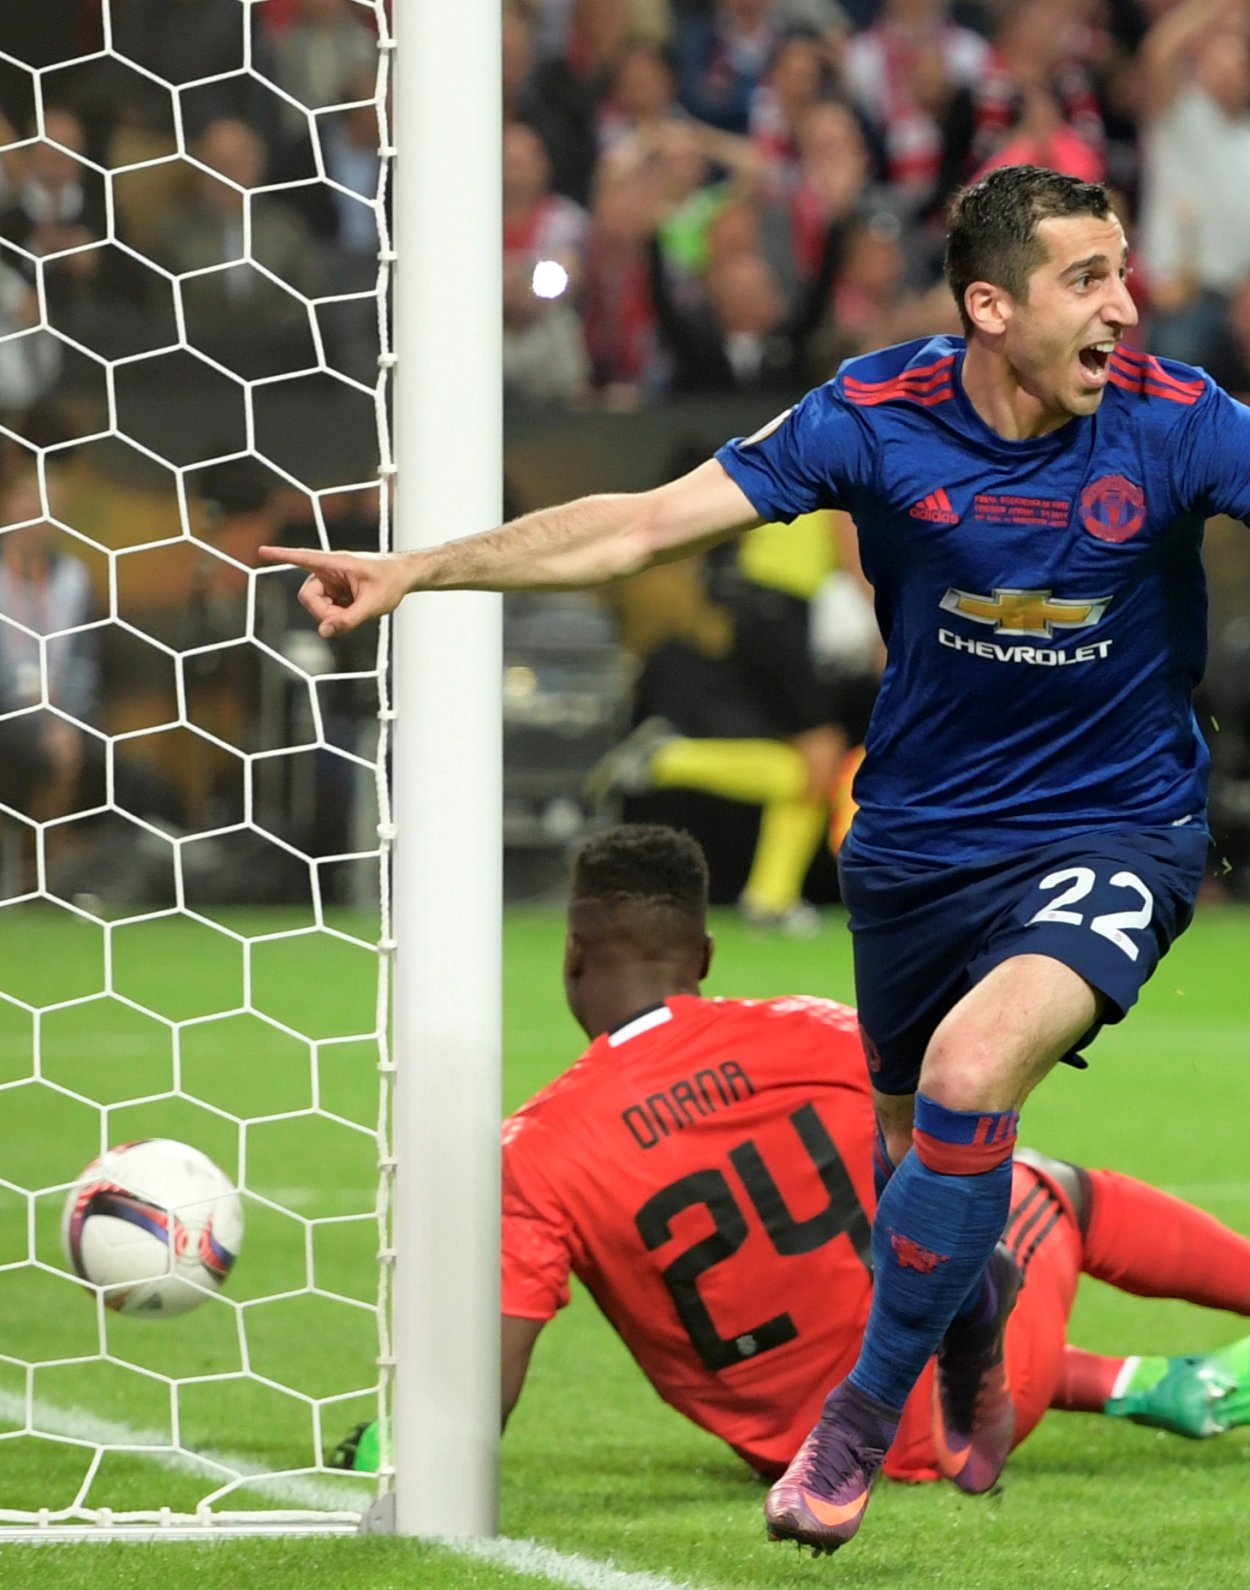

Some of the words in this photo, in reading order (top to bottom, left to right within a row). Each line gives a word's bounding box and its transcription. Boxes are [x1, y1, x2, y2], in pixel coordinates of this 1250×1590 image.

[909, 508, 960, 524] adidas
[938, 628, 1113, 666] CHEVROLET
[1024, 866, 1154, 962] 22
[621, 1061, 756, 1150] ONANA
[634, 1102, 874, 1372] 24
